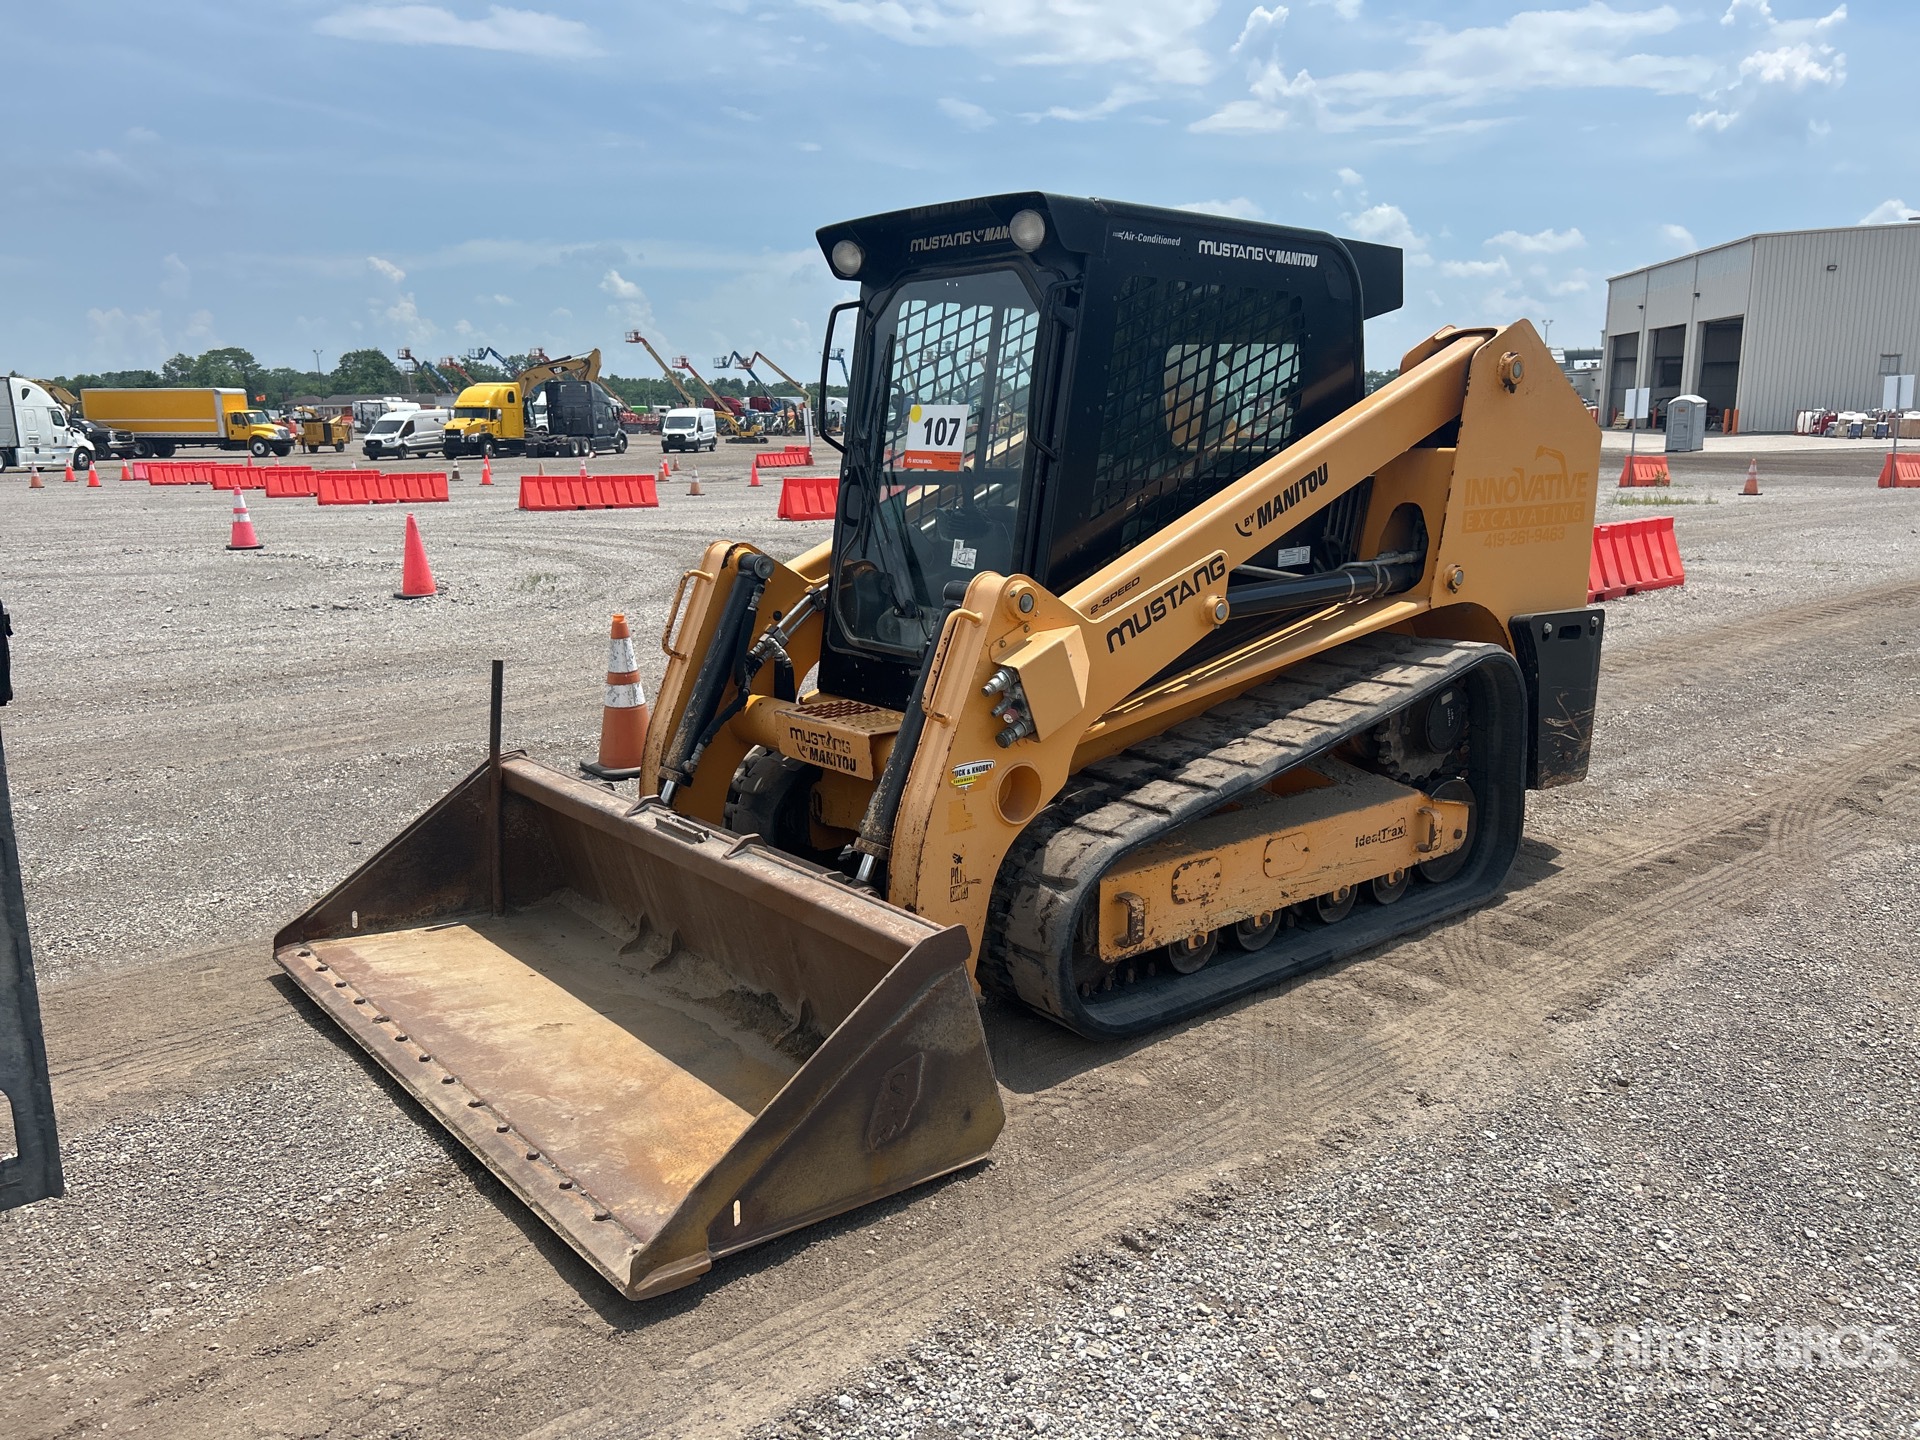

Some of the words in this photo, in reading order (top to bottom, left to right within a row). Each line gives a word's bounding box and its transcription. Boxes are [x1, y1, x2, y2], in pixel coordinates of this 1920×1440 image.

[910, 231, 972, 252] MUSTANG
[984, 225, 1011, 242] MAN
[1123, 233, 1181, 246] Air-Conditioned
[1199, 240, 1264, 261] MUSTANG
[1275, 250, 1319, 268] MANITOU
[924, 417, 961, 446] 107
[1244, 513, 1255, 527] BY
[1257, 462, 1329, 529] MANITOU
[1464, 470, 1589, 507] INNOVATIVE
[1465, 504, 1582, 530] EXCAVATING
[1483, 526, 1566, 549] 419-261-9463
[1090, 576, 1141, 615] 2-SPEED
[1106, 555, 1226, 653] MUSTANG
[790, 727, 851, 754] MUSTANG
[809, 747, 857, 773] MANITOU
[952, 769, 966, 778] UCK
[1355, 825, 1404, 849] IdealTrax
